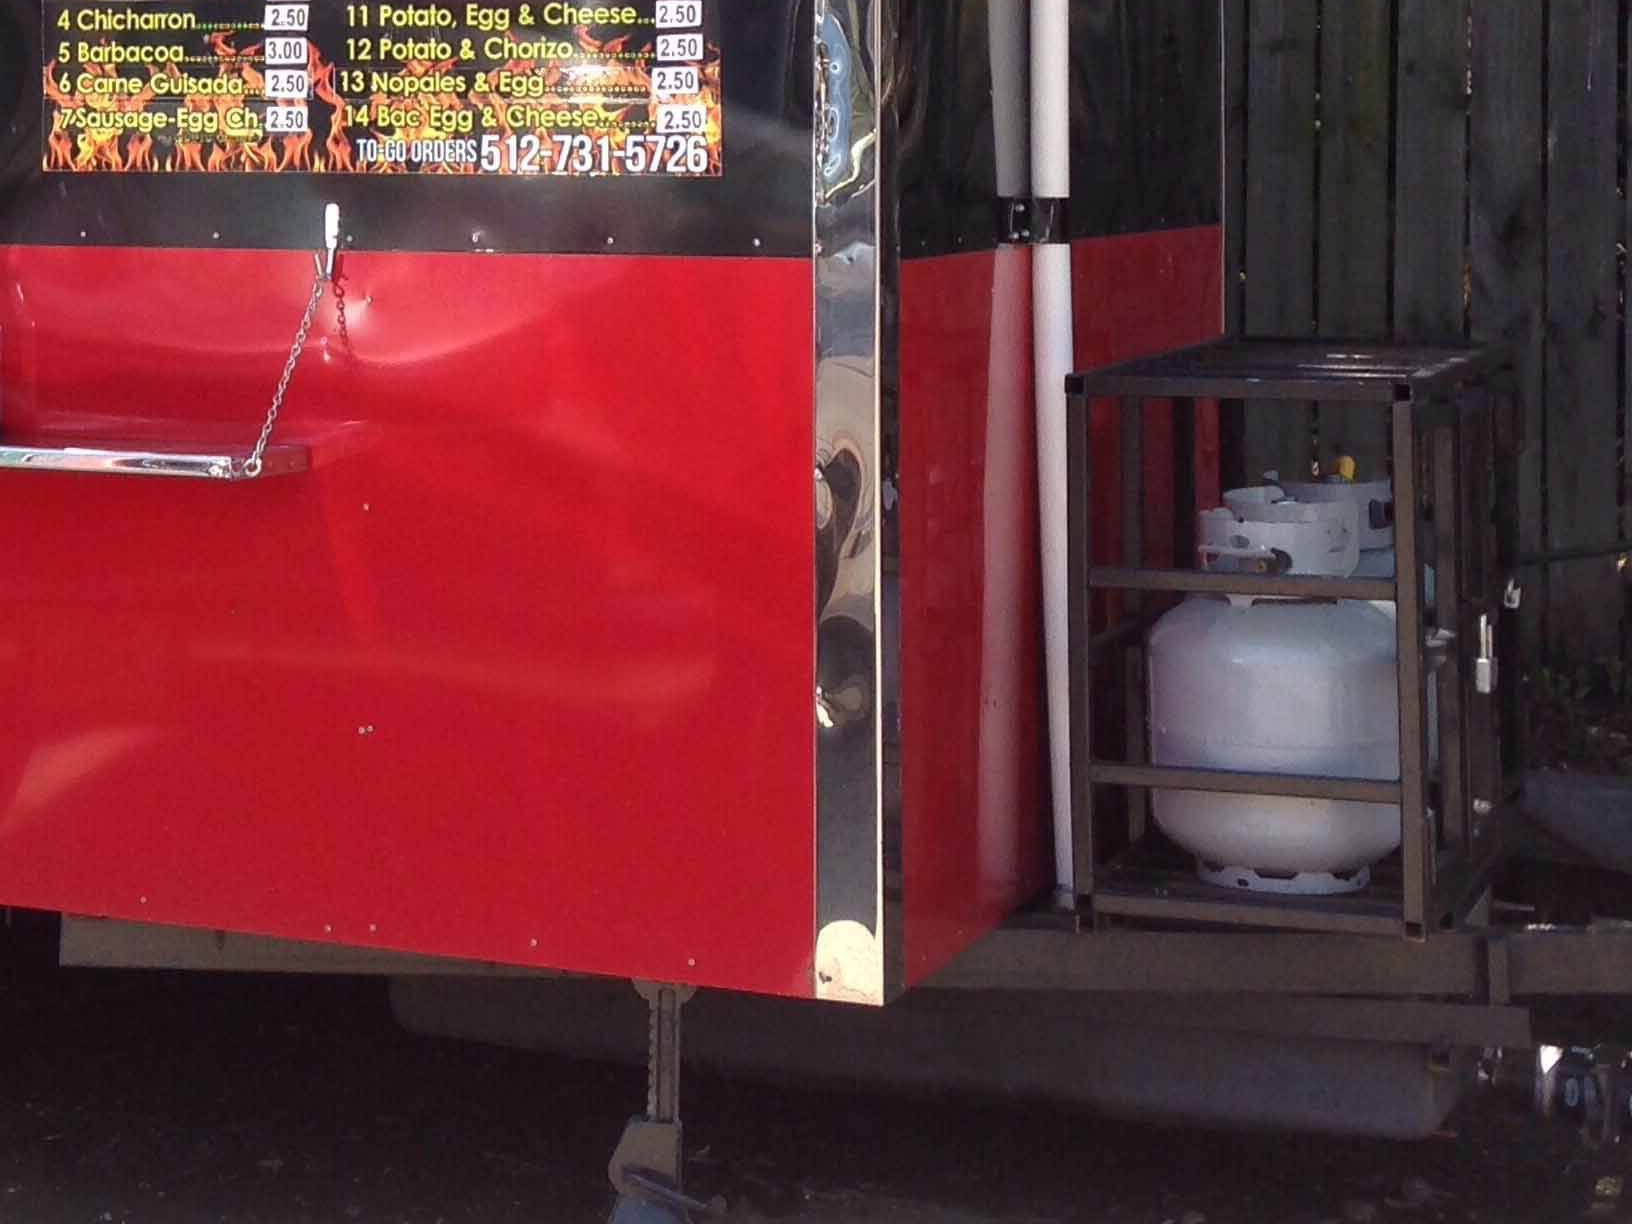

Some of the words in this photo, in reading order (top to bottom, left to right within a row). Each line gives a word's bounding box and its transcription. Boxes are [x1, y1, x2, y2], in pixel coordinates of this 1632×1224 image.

[57, 11, 70, 29] 4
[77, 9, 195, 30] Chicharron
[271, 8, 305, 26] 2.50
[346, 7, 369, 27] 11
[379, 5, 457, 28] Potato,
[466, 6, 510, 30] Egg
[518, 5, 534, 25] &
[543, 2, 637, 25] Cheese
[660, 4, 696, 23] 2.50
[58, 43, 70, 62] 5
[78, 42, 184, 63] Barbacoa
[268, 42, 302, 60] 3.00
[346, 41, 371, 60] 12
[379, 39, 452, 60] Potato
[460, 39, 475, 59] &
[484, 37, 573, 60] Chorizo
[661, 38, 698, 57] 2.50
[59, 75, 71, 93] 6
[77, 75, 142, 94] Carne
[151, 75, 243, 94] Guisada
[271, 75, 304, 92] 2.50
[341, 73, 364, 91] 13
[371, 72, 466, 98] Nopales
[474, 72, 490, 92] &
[500, 72, 544, 97] Egg
[657, 72, 694, 89] 2.50
[76, 108, 217, 132] Sausage-Egg
[271, 111, 303, 128] 2.50
[346, 105, 369, 126] 14
[378, 106, 420, 126] Bac
[430, 105, 473, 132] Egg
[481, 107, 497, 126] &
[507, 105, 600, 127] Cheese
[665, 111, 701, 129] 2.50
[411, 139, 477, 163] ORDERS
[481, 134, 708, 172] 512-731-5726
